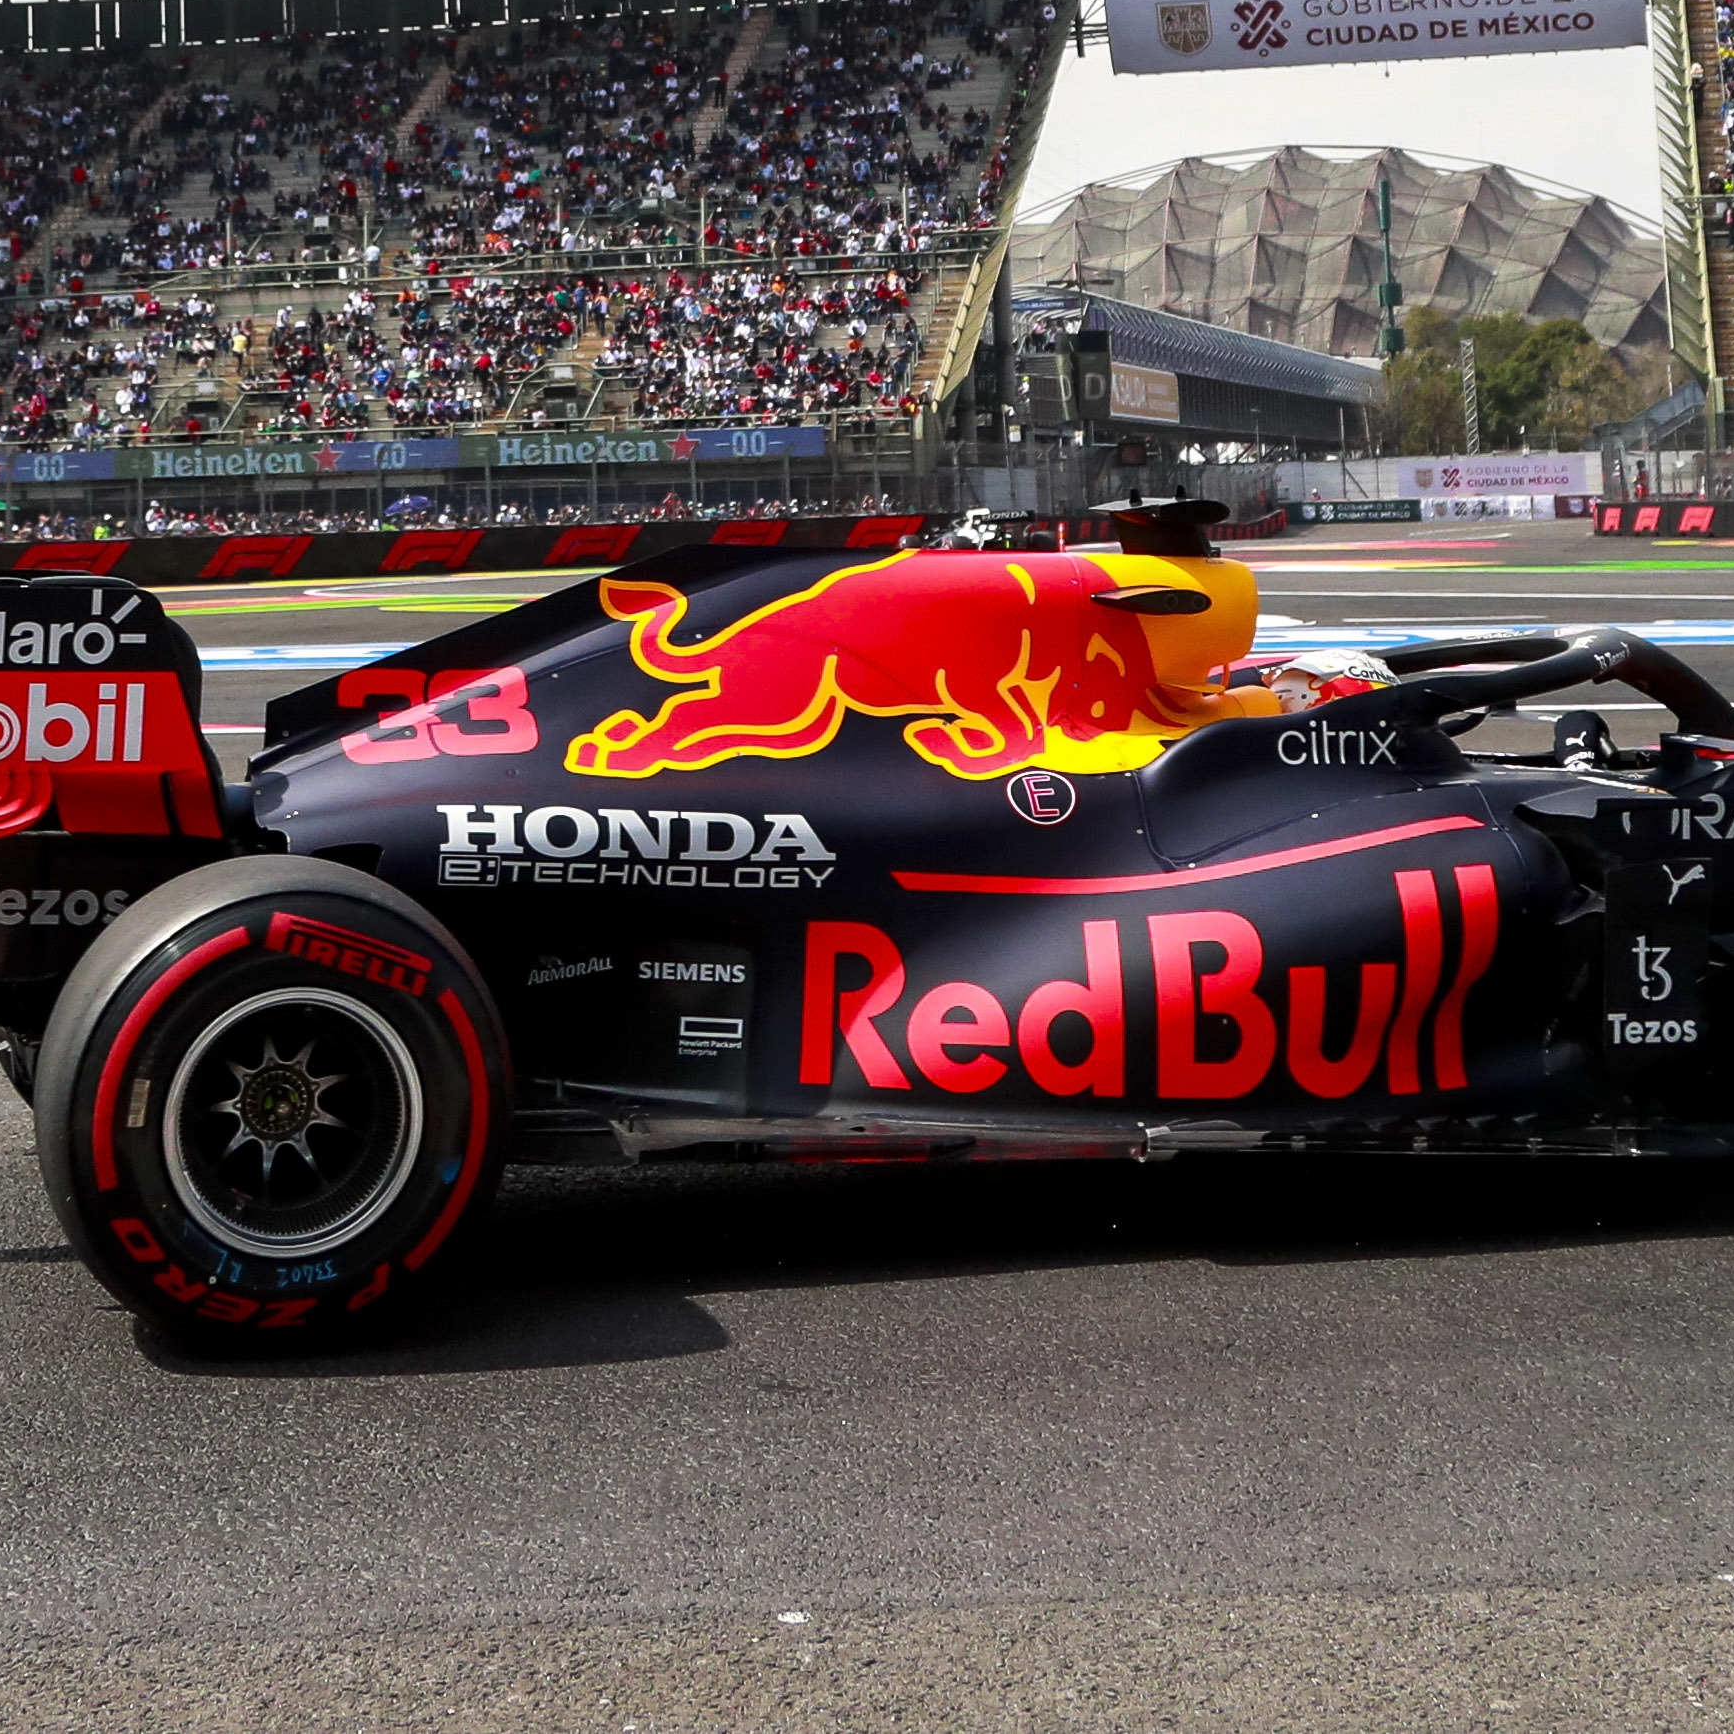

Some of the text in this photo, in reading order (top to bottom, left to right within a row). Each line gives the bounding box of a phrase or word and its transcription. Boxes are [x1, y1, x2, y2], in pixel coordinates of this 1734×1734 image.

[1305, 10, 1595, 48] CIUDAD DE MÉXICO
[151, 448, 306, 478] Heineken
[497, 434, 659, 466] Heineken
[1466, 466, 1529, 475] GOBIERNO
[1533, 465, 1549, 473] DE
[1467, 474, 1570, 488] CIUDAD DE MÉXICO
[337, 665, 539, 765] 33
[1277, 719, 1398, 765] citrix
[436, 804, 837, 862] HONDA
[265, 911, 434, 996] PIRELLI
[638, 961, 747, 984] SIEMENS
[1607, 1012, 1698, 1044] Tezos
[677, 1047, 718, 1057] Enterprise
[711, 1040, 743, 1050] Packard
[111, 1217, 320, 1328] ZERO
